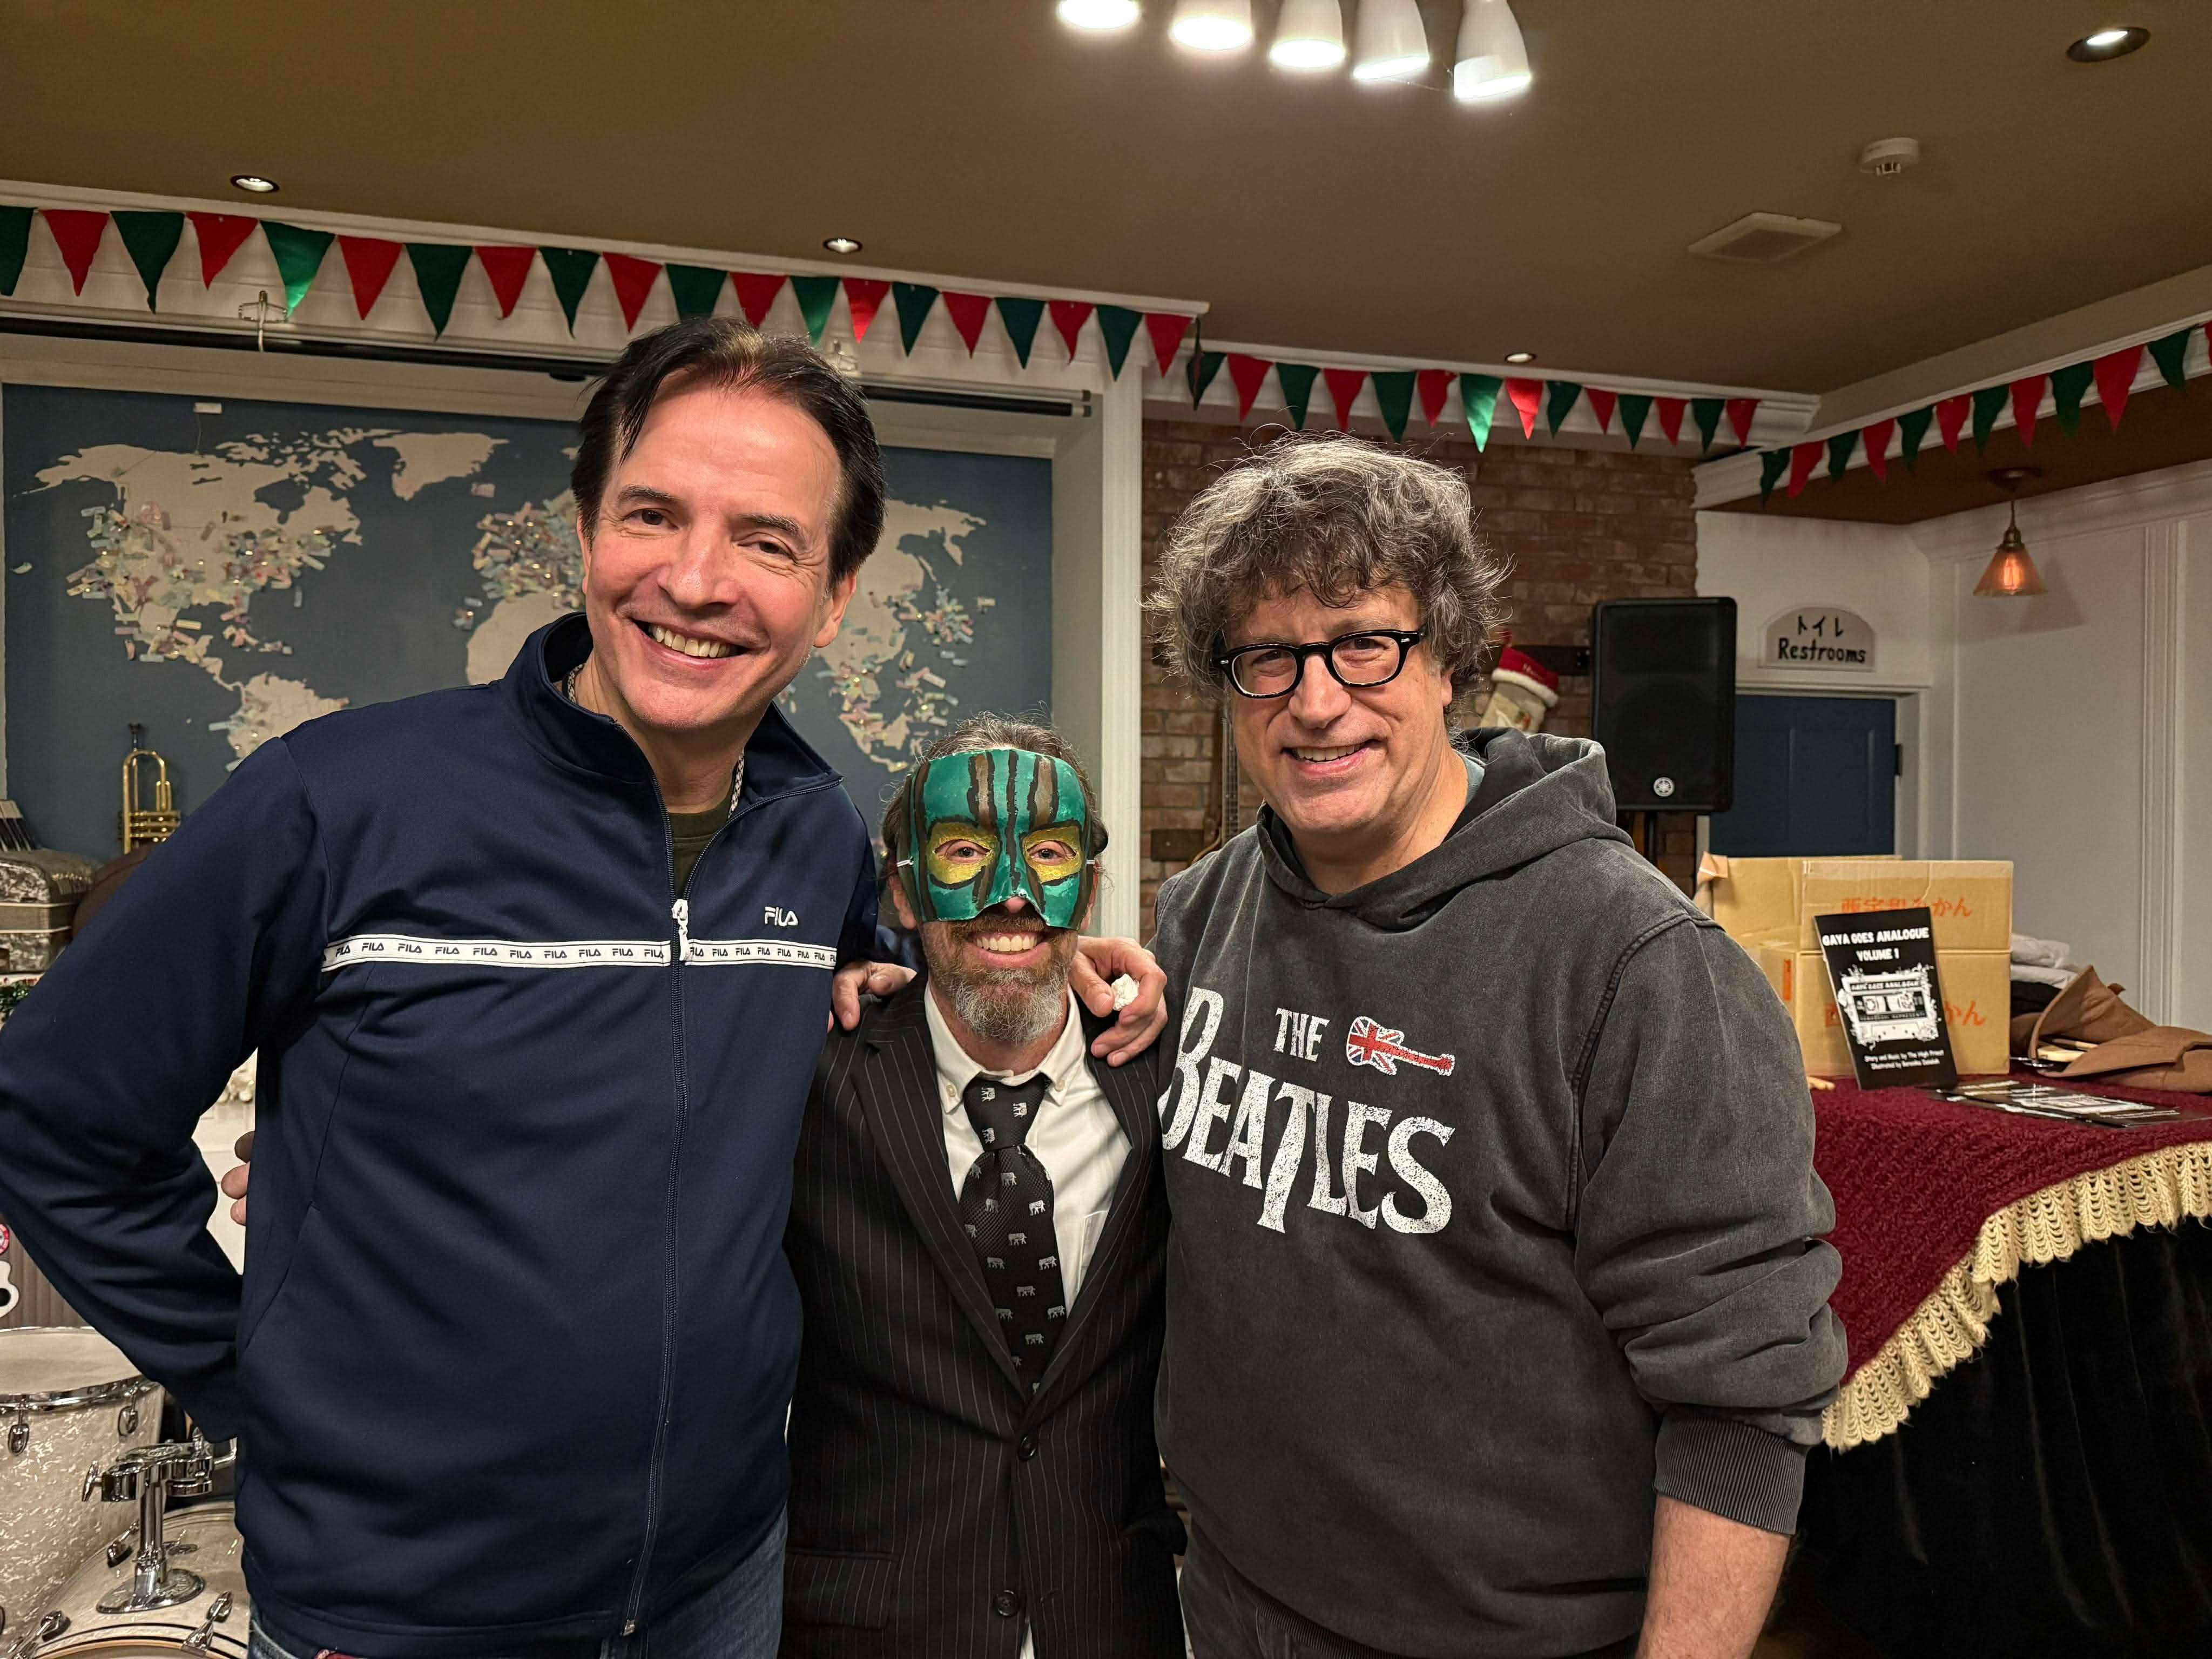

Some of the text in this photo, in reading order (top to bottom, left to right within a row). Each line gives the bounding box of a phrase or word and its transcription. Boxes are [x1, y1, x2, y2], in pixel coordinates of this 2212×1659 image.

[1797, 615, 1844, 638] トイレ
[1778, 637, 1867, 664] Restrooms
[764, 906, 799, 927] FILA
[1851, 932, 1874, 944] GOES
[1877, 927, 1930, 942] ANALOGUE
[362, 942, 385, 952] FILA
[397, 943, 422, 953] FILA
[435, 947, 460, 955] FILA
[473, 947, 498, 956] FILA
[509, 949, 532, 959] FILA
[544, 950, 567, 959] FILA
[578, 949, 601, 957] FILA
[612, 948, 633, 956] FILA
[644, 949, 664, 959] FILA
[735, 947, 751, 955] FILA
[757, 947, 771, 955] FILA
[777, 948, 791, 957] FILA
[797, 950, 810, 959] FILA
[814, 952, 825, 961] FILA
[1856, 948, 1900, 961] VOLUME 1
[1273, 1007, 1330, 1062] THE
[1157, 986, 1456, 1234] BEATLES
